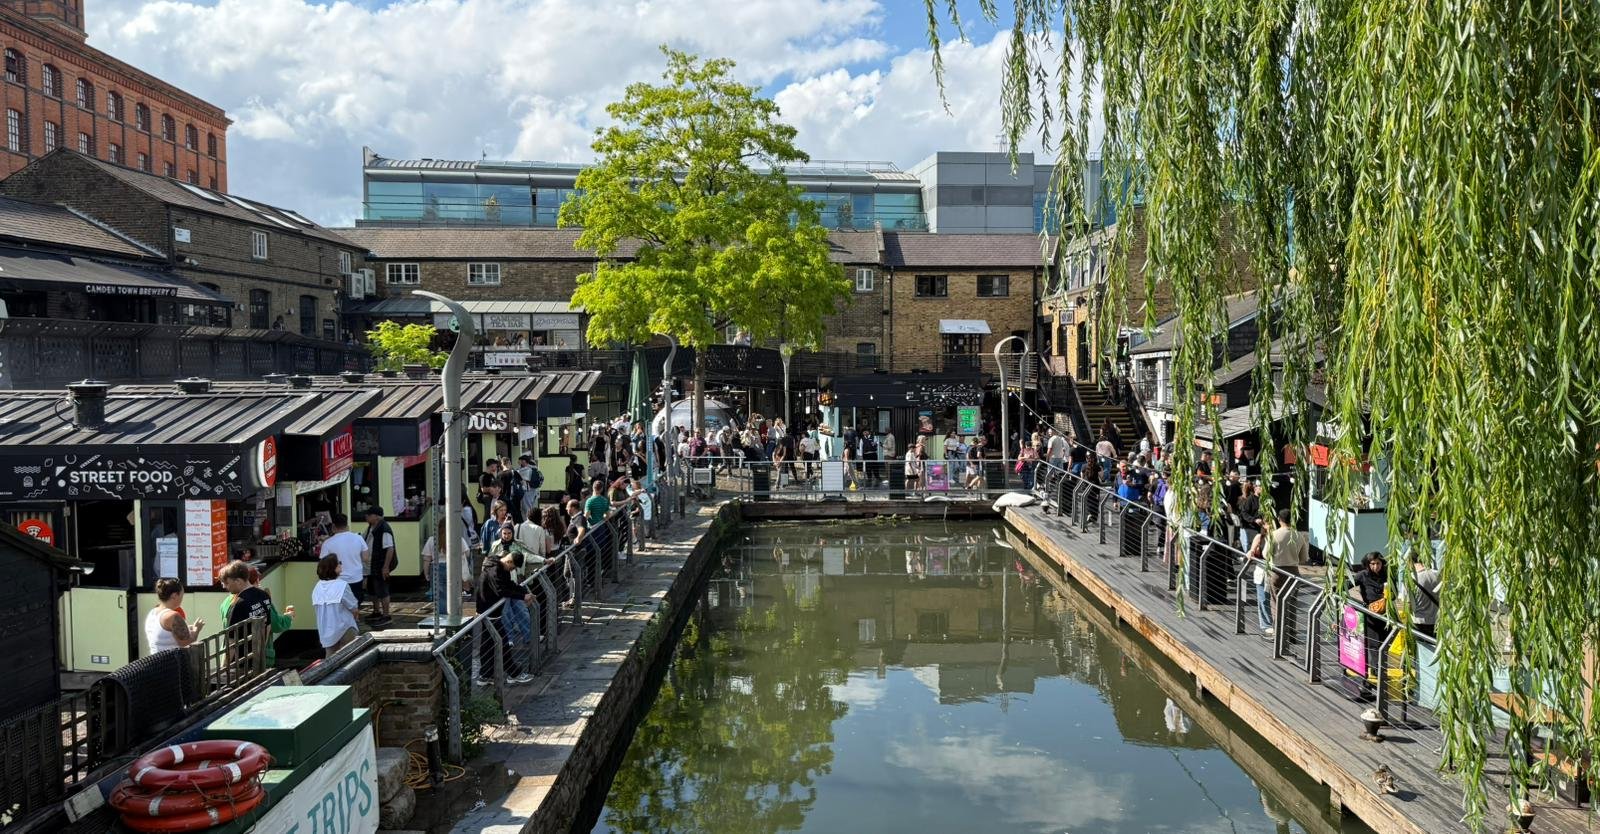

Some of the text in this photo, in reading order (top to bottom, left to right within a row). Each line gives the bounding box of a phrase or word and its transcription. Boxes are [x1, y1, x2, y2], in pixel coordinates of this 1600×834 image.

[86, 285, 170, 296] CAMDEN TOWN BREWERY
[69, 470, 173, 483] STREET FOOD
[307, 758, 372, 834] TRIPS
